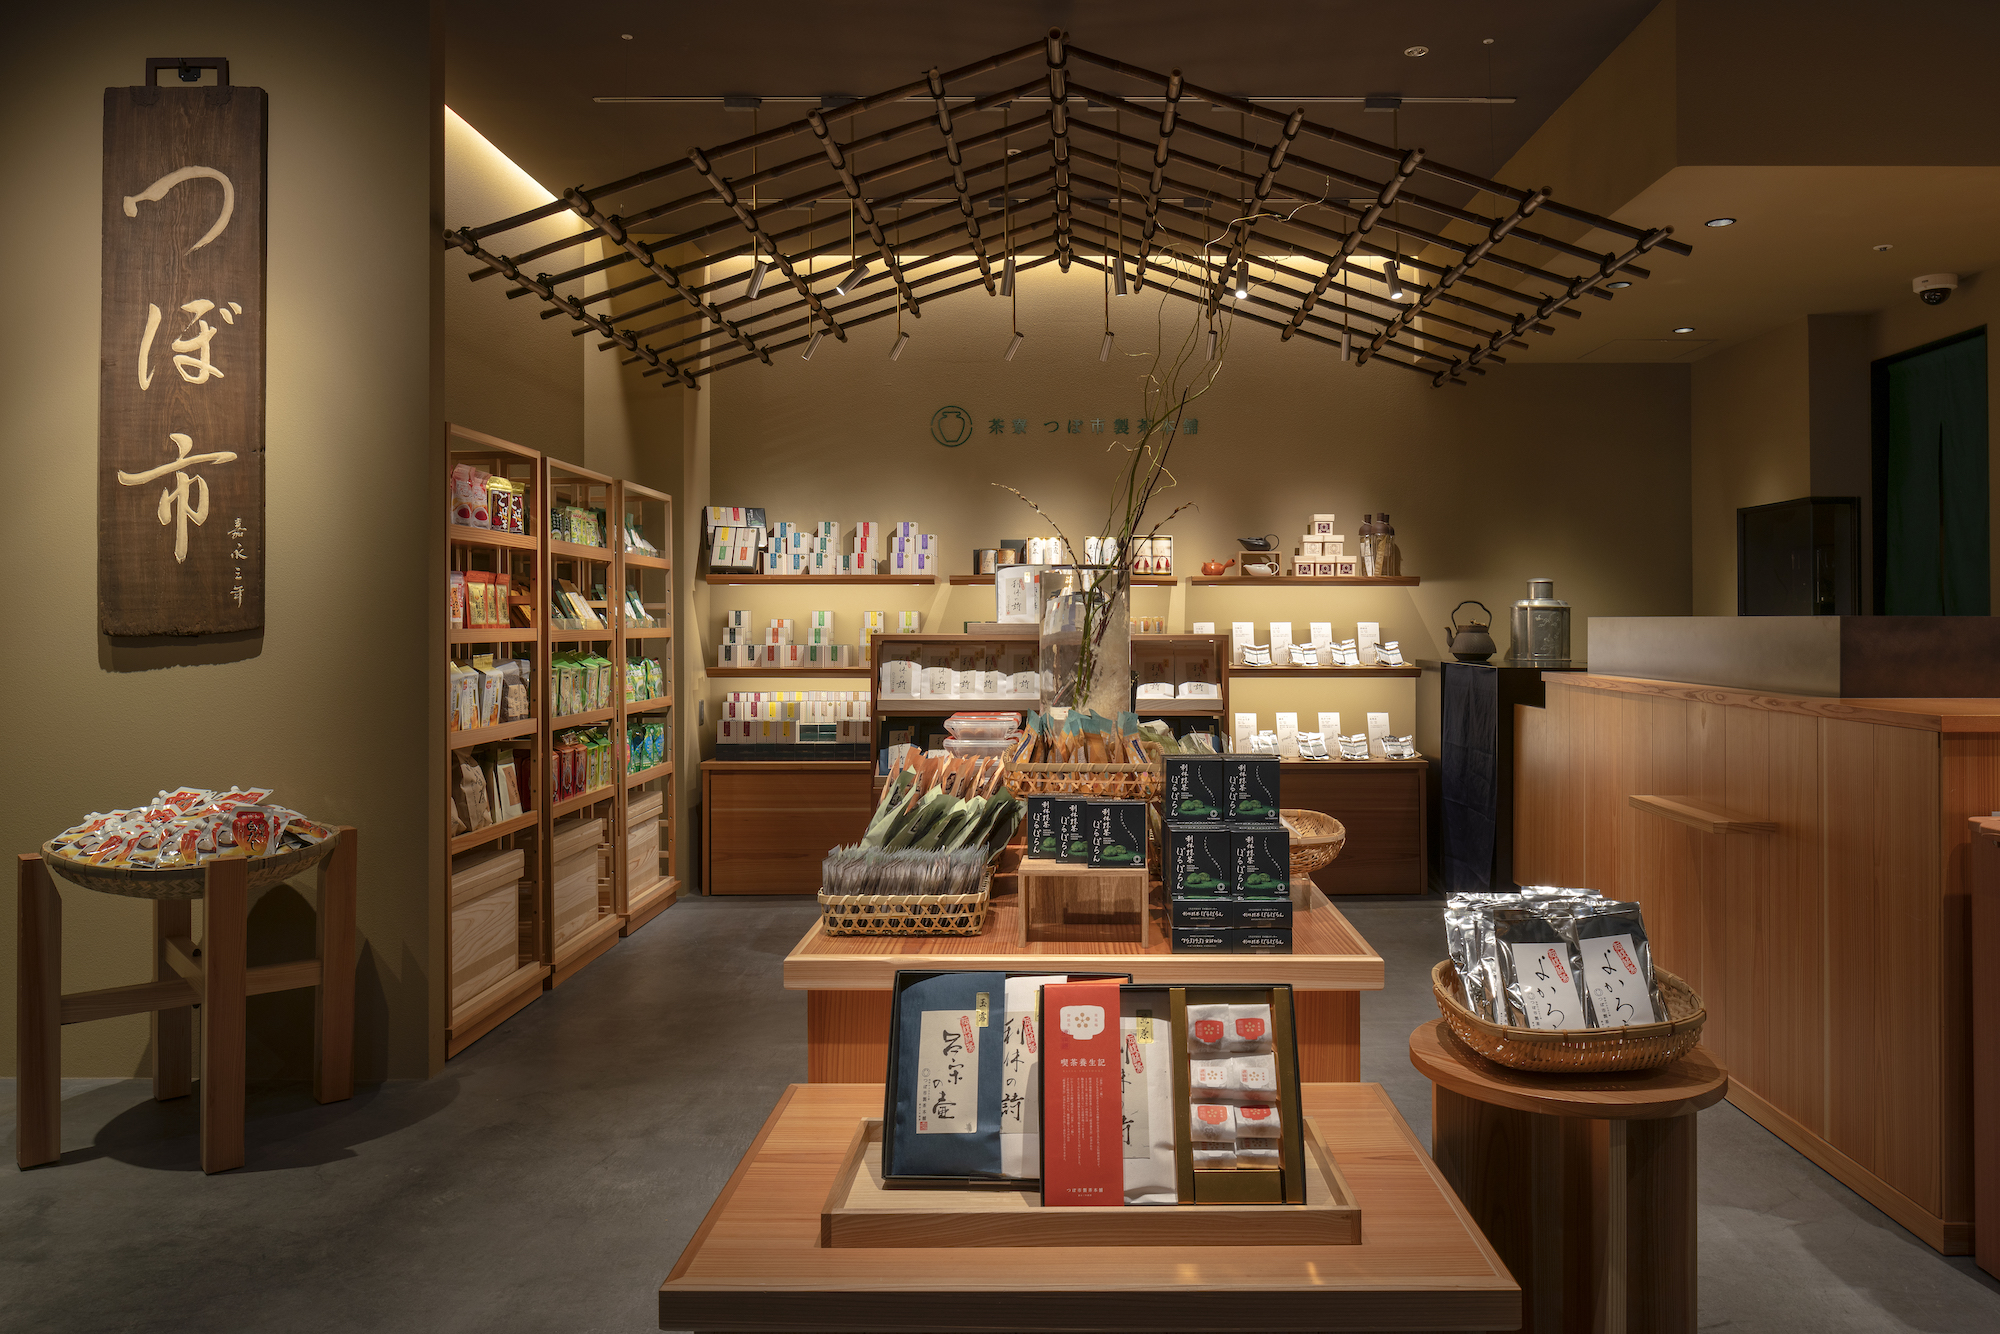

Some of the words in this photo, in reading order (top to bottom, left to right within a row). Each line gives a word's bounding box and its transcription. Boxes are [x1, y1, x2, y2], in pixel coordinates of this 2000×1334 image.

[117, 165, 242, 564] つぼ市
[988, 418, 1028, 434] 茶寮
[1043, 418, 1199, 435] つぼ市製茶本舗
[227, 518, 249, 608] 嘉永三年
[1060, 1058, 1106, 1068] 喫茶養生記
